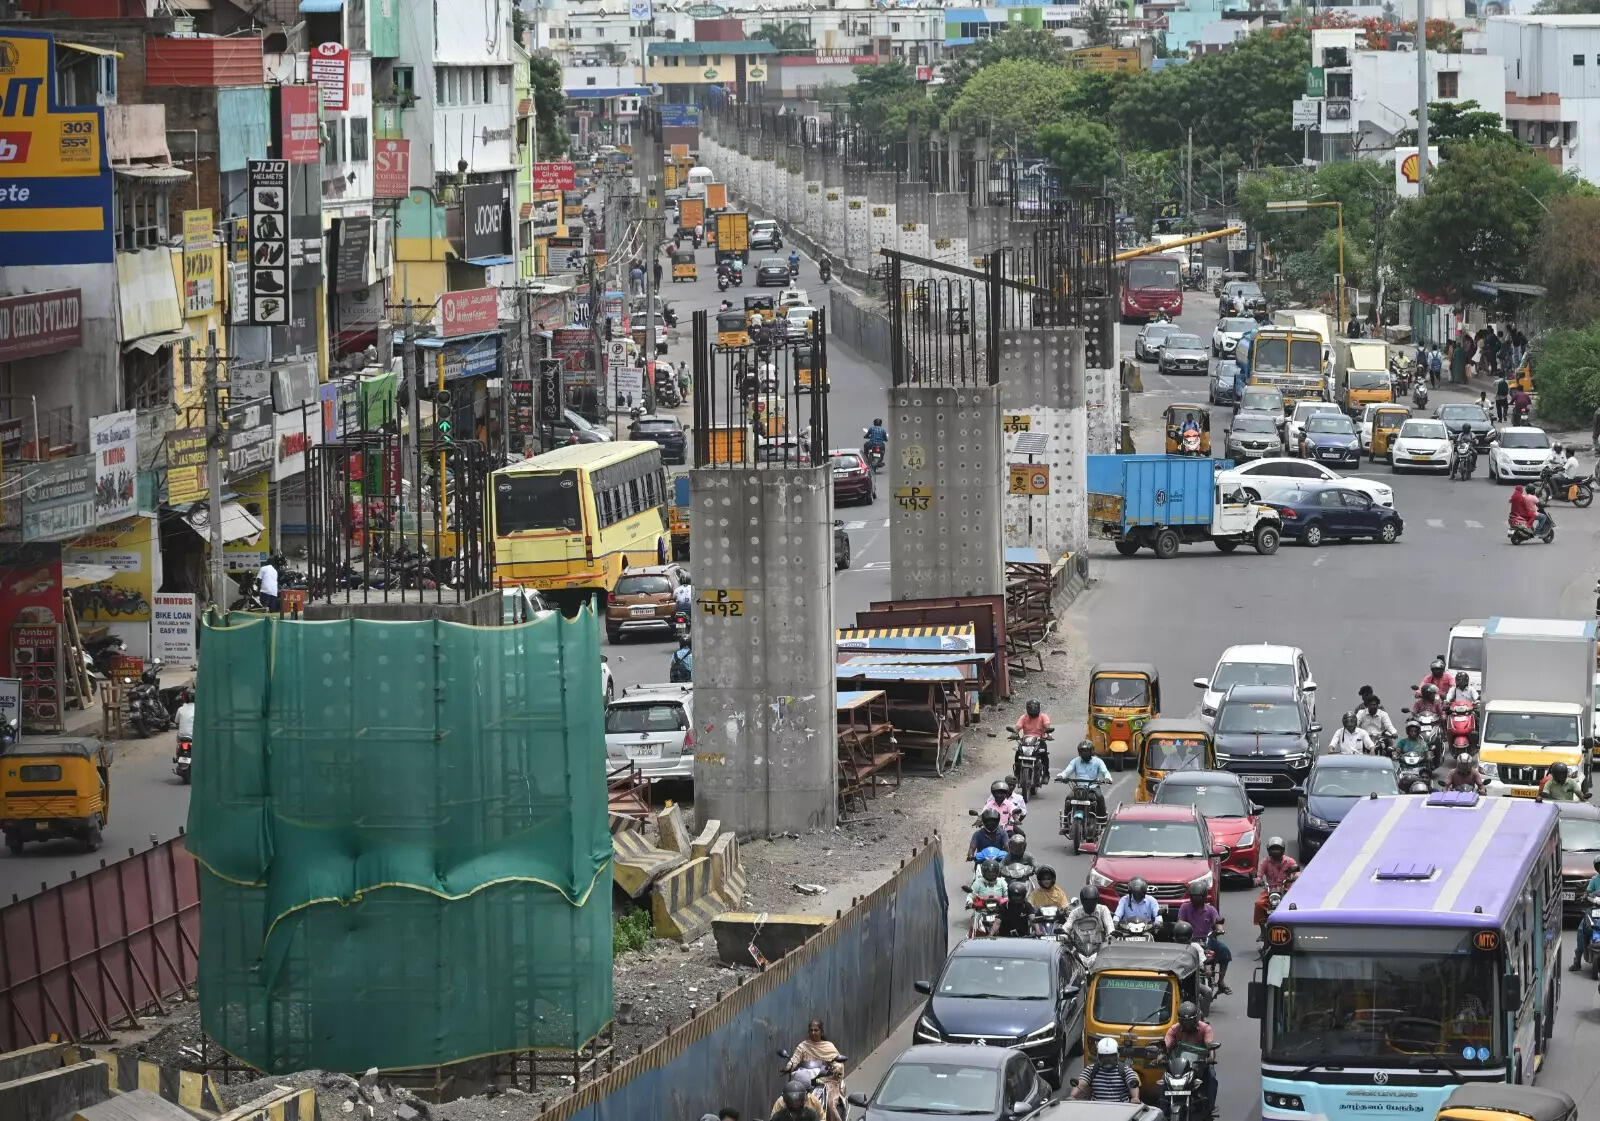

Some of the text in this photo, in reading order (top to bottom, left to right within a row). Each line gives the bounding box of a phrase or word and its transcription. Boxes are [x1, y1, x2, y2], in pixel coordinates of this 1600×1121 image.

[64, 122, 92, 134] 303
[252, 162, 285, 173] JIJO
[376, 152, 409, 171] ST
[474, 204, 503, 235] JOCKEY
[13, 302, 41, 339] CHITS
[1012, 416, 1021, 424] P
[911, 487, 921, 497] P
[899, 498, 931, 511] 493
[154, 597, 193, 605] VI MOTORS
[717, 589, 728, 602] P
[155, 611, 192, 619] BIKE LOAN
[704, 603, 743, 617] 492
[20, 628, 53, 636] Ambur
[18, 637, 55, 646] Briyani
[1271, 929, 1287, 943] MTC
[1478, 934, 1496, 948] MTC
